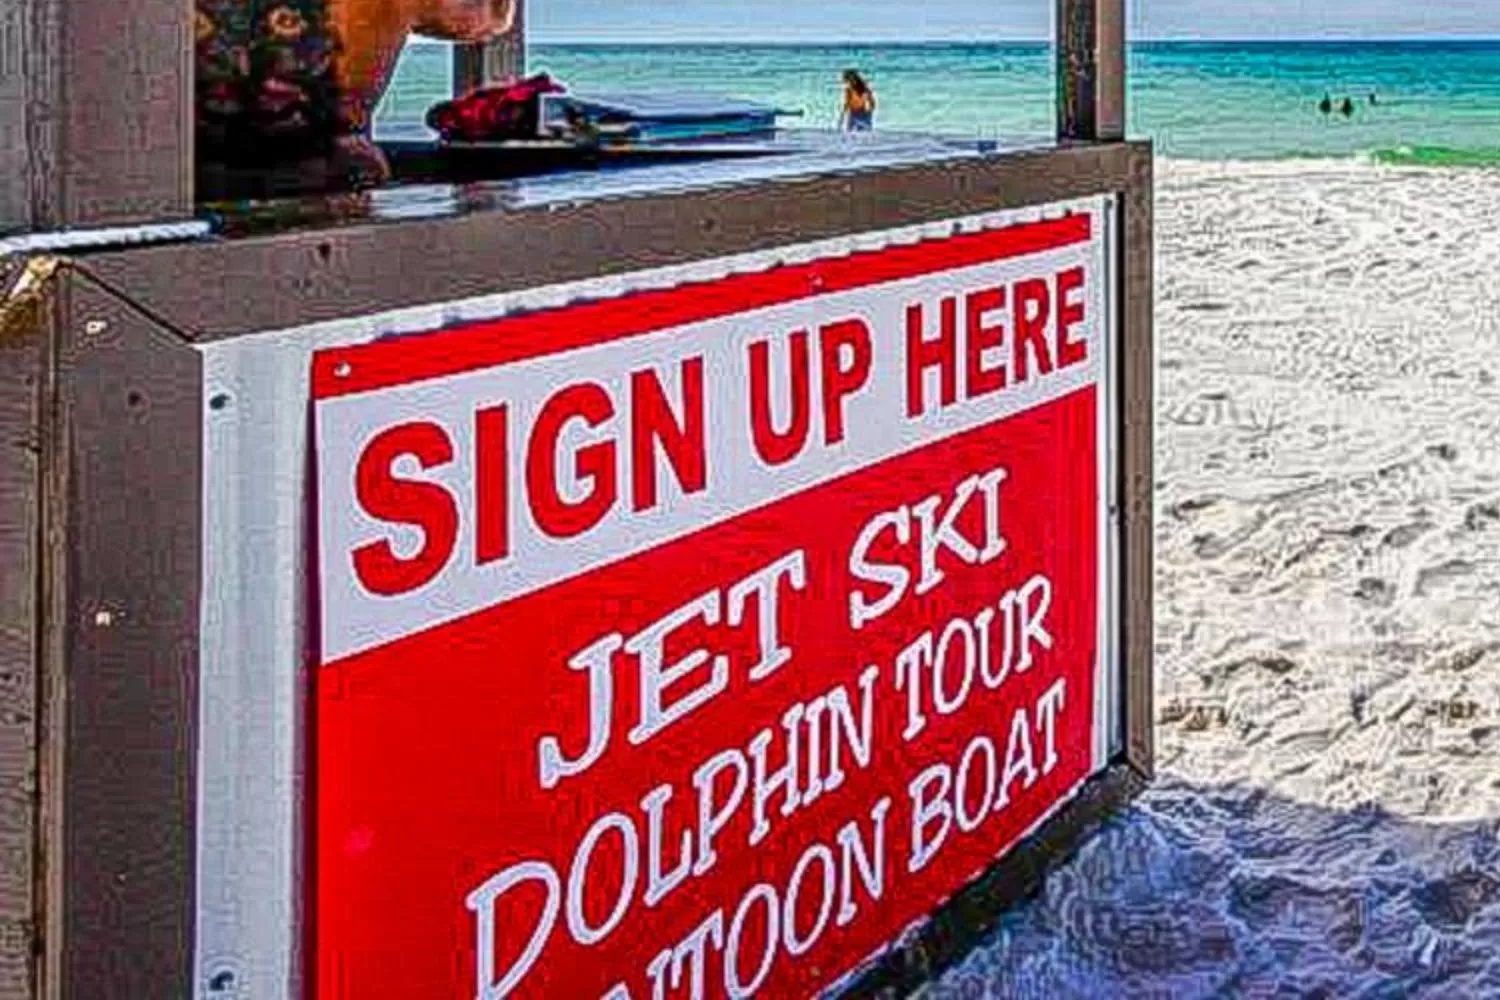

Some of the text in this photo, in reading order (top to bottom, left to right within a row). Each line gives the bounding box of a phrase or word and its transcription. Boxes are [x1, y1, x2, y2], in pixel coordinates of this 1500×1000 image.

[350, 266, 1088, 598] SIGN UP HERE
[466, 573, 1054, 1000] DOLPHIN TOUR
[537, 467, 1008, 790] JET SKI
[905, 676, 1066, 874] BOAT
